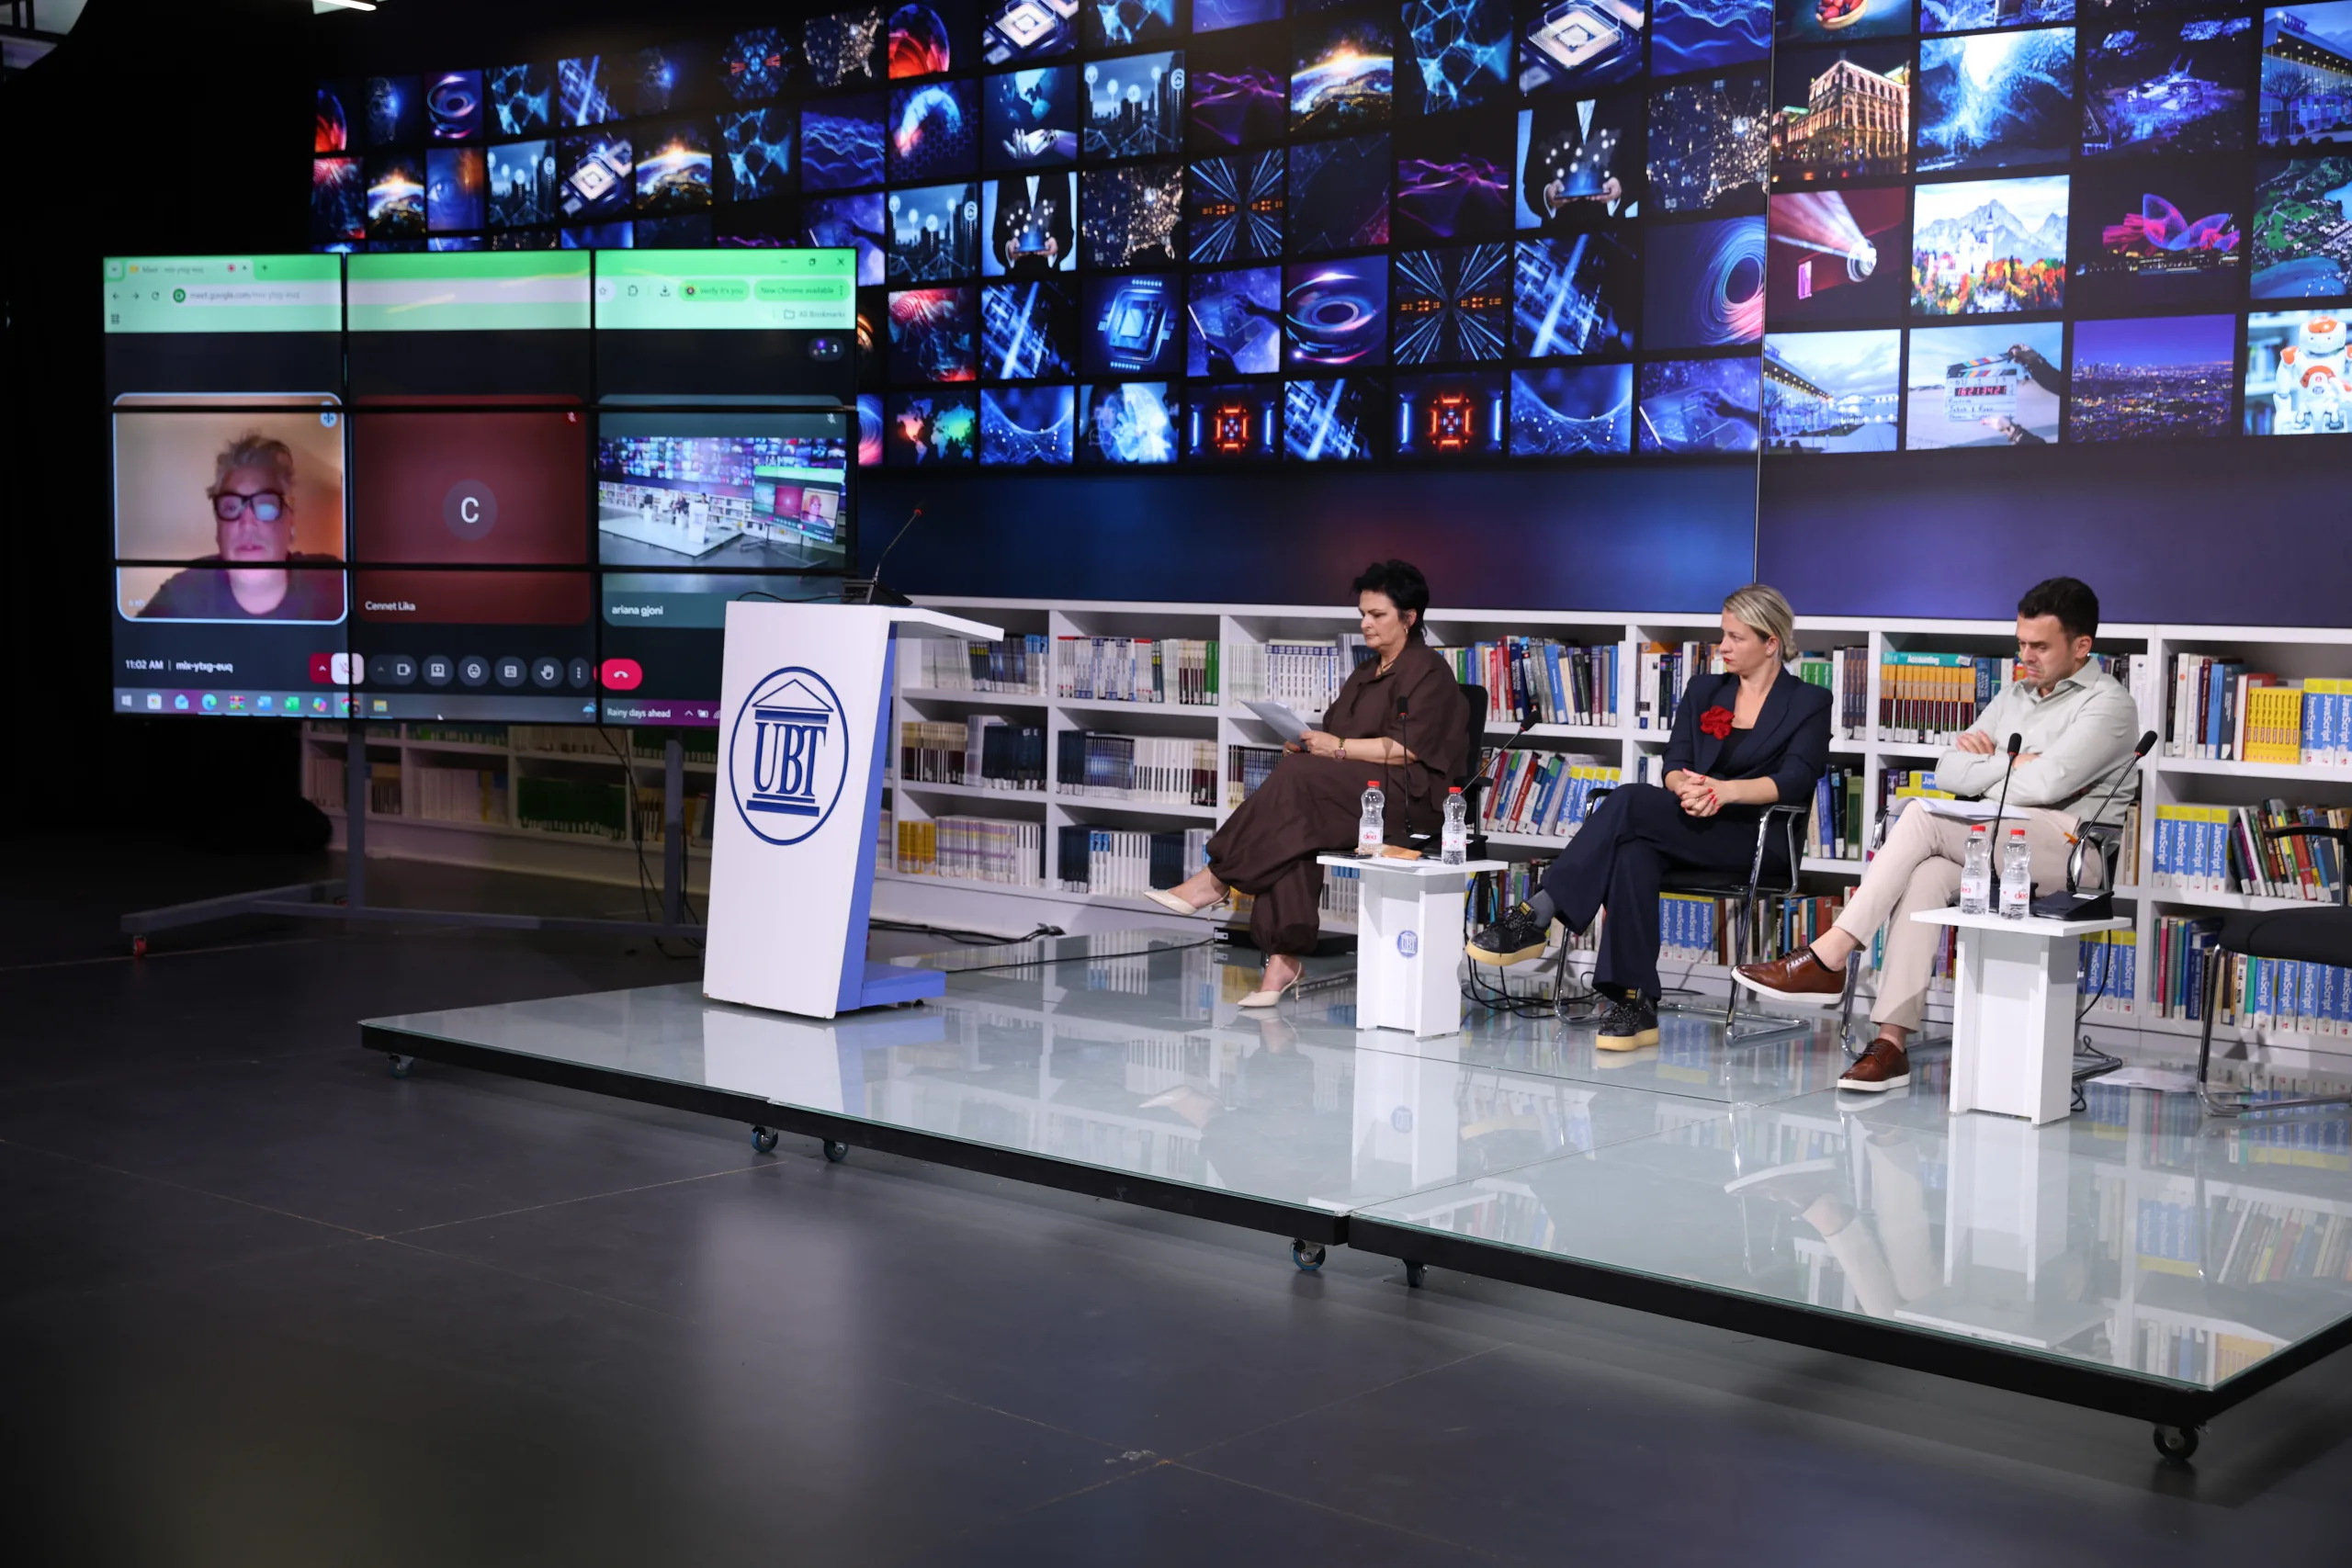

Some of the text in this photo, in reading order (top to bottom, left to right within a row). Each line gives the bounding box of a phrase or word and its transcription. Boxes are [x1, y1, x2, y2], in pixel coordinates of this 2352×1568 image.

[730, 288, 744, 296] you
[831, 344, 838, 354] 3
[460, 496, 480, 524] C
[365, 601, 416, 612] Cennet Lika
[611, 604, 663, 617] ariana gjoni
[126, 660, 147, 670] 11:02
[149, 660, 164, 670] AM
[1907, 654, 1939, 666] Accounting
[607, 707, 671, 719] Rainy days ahead
[2304, 694, 2316, 740] JavaScript
[2321, 694, 2334, 741] JavaScript
[2339, 695, 2352, 743] JavaScript
[753, 722, 827, 796] UBT
[2156, 820, 2169, 864] JavaScript
[2174, 821, 2187, 866] JavaScript
[2192, 823, 2205, 867] JavaScript
[2211, 824, 2223, 869] JavaScript
[1661, 900, 1670, 938] JavaScript
[1676, 900, 1684, 940] JavaScript
[1688, 902, 1697, 941] JavaScript
[1702, 904, 1711, 942] JavaScript
[2123, 946, 2135, 990] JavaScript
[2257, 961, 2271, 1006] JavaScript
[2280, 962, 2293, 1008] JavaScript
[2301, 962, 2315, 1009] JavaScript
[2322, 964, 2335, 1010] JavaScript
[2340, 967, 2352, 1012] JavaScript
